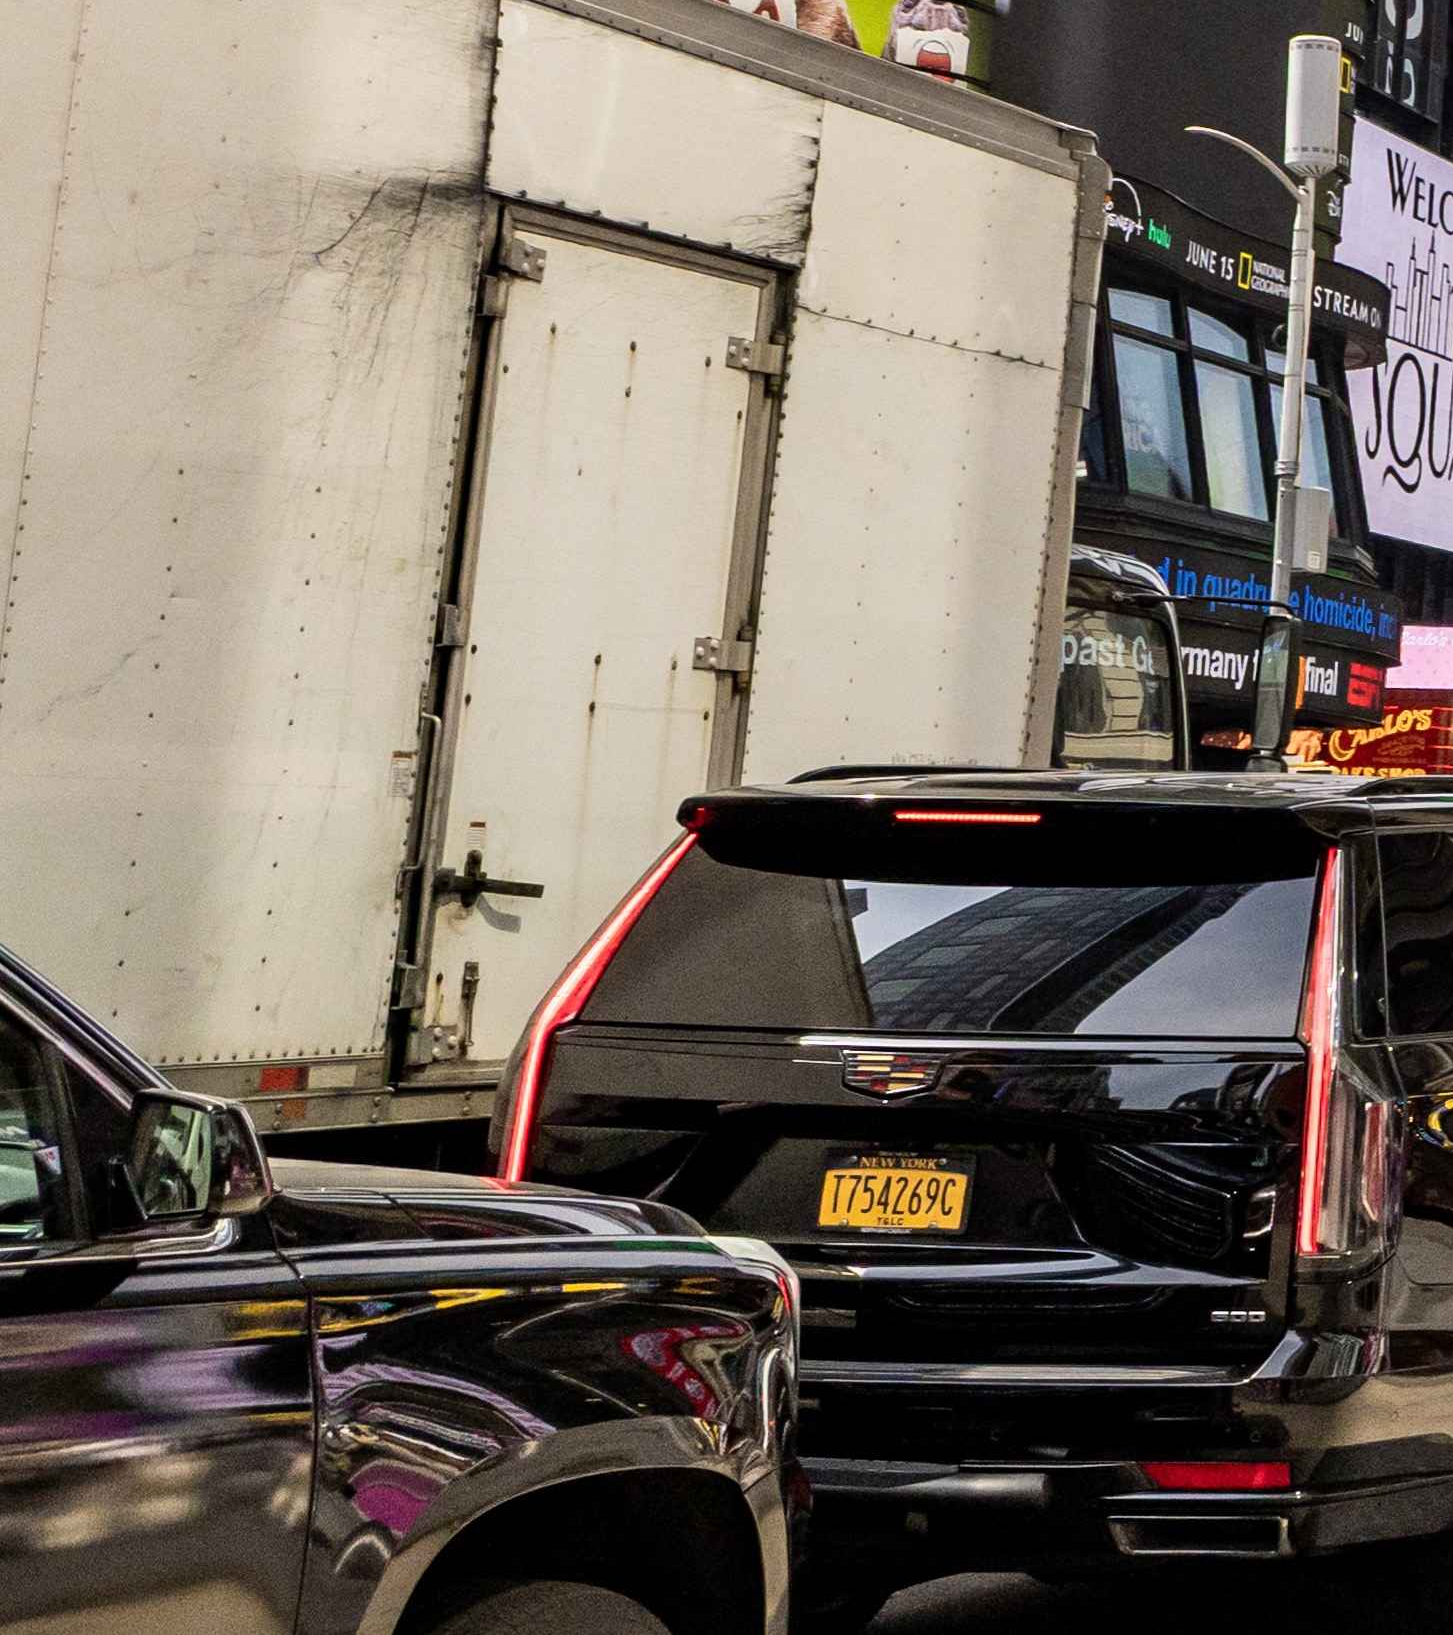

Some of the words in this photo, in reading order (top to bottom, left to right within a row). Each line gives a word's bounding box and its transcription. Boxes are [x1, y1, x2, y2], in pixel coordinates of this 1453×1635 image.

[1147, 217, 1173, 250] hulu
[1185, 240, 1218, 274] JUNE
[1220, 255, 1236, 281] 15
[1312, 285, 1370, 322] STREAM
[1176, 559, 1197, 598] in
[1303, 584, 1377, 642] homicide,
[1305, 652, 1339, 697] final
[1328, 708, 1433, 762] CARLO'S
[859, 1156, 897, 1169] NEW
[900, 1158, 938, 1170] YORK
[832, 1173, 957, 1216] T754269C
[1210, 1310, 1267, 1323] 600
